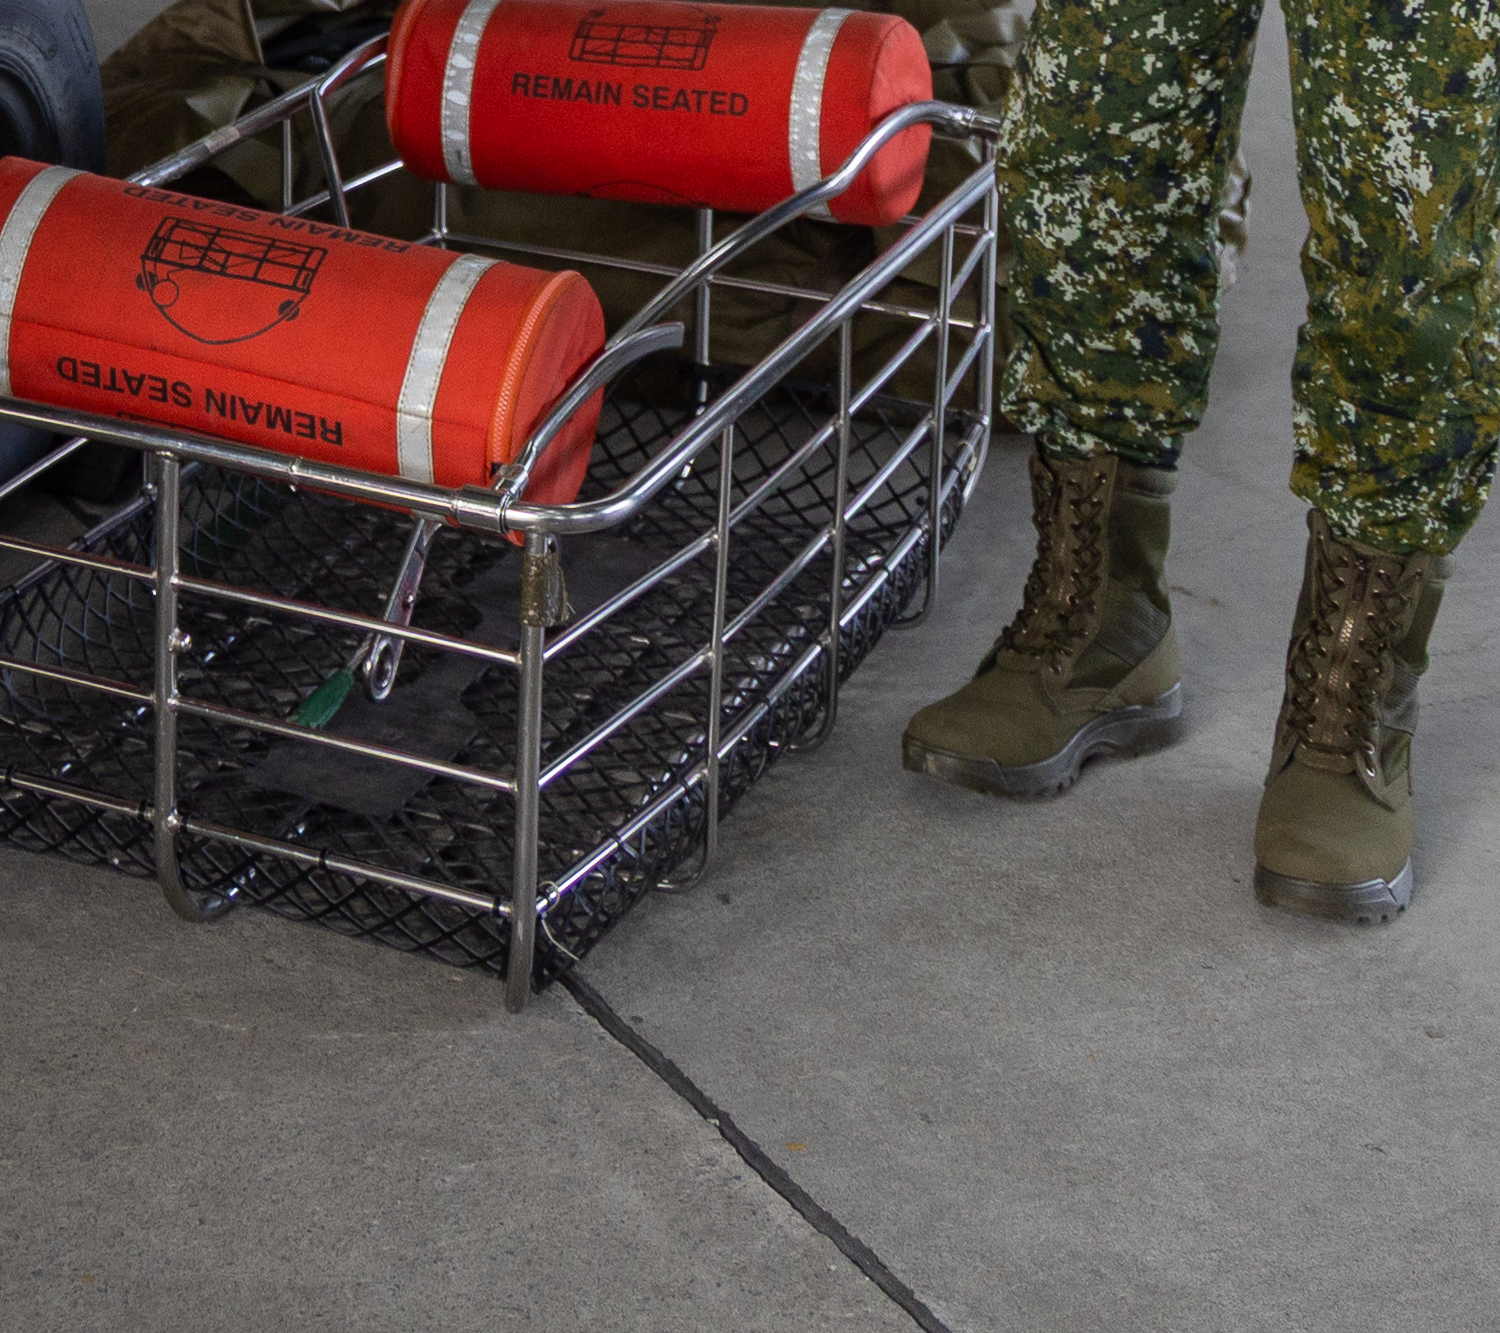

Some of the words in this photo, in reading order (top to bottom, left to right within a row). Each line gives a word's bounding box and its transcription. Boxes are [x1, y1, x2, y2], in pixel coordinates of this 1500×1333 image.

[511, 72, 623, 106] REMAIN
[632, 84, 749, 117] SEATED
[122, 186, 260, 221] SEATED
[272, 214, 413, 254] REMAIN
[56, 356, 192, 408] SEATED
[205, 388, 343, 446] REMAIN
